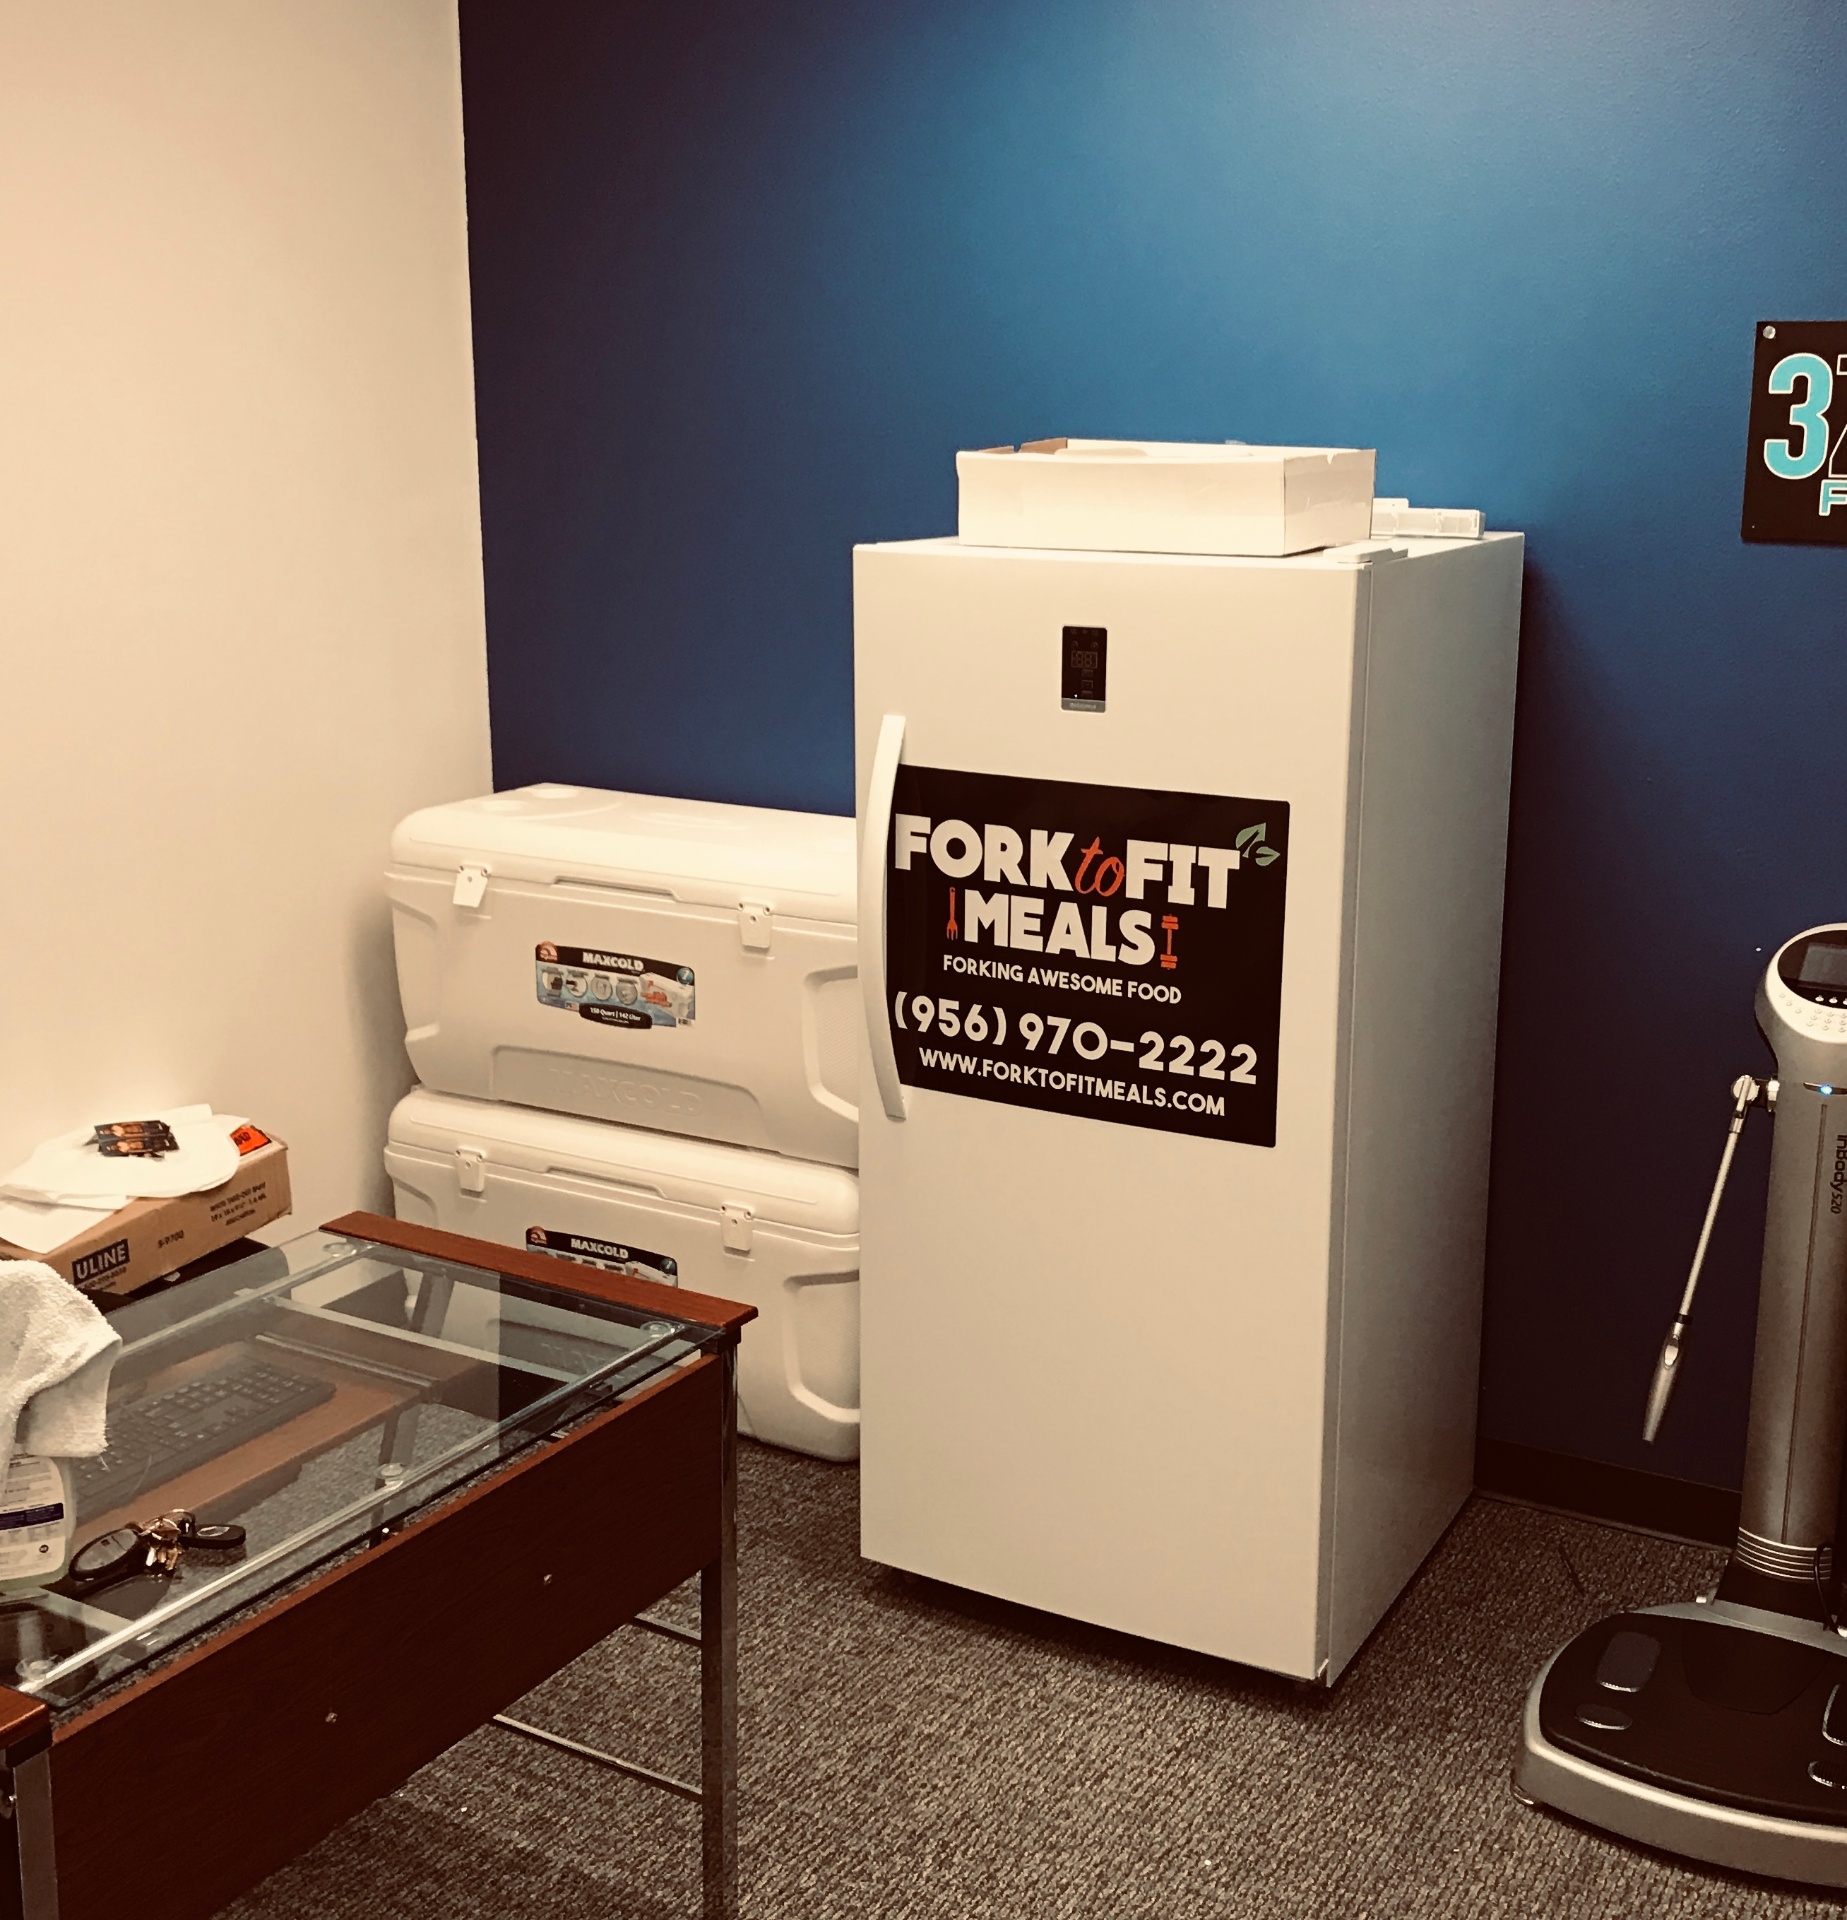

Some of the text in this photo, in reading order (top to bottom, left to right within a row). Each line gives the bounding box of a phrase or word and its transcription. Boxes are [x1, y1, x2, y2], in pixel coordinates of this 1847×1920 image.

[895, 813, 1241, 909] FORK to FIT
[964, 889, 1156, 966] MEALS
[582, 951, 645, 972] MAXCOLD
[943, 954, 1182, 1004] FORKING AWESOME FOOD
[895, 991, 1258, 1085] (956) 970-2222
[919, 1047, 1226, 1117] WWW.FORKTOFITMEALS.COM
[76, 1242, 127, 1279] ULINE
[570, 1238, 630, 1260] MAXCOLD
